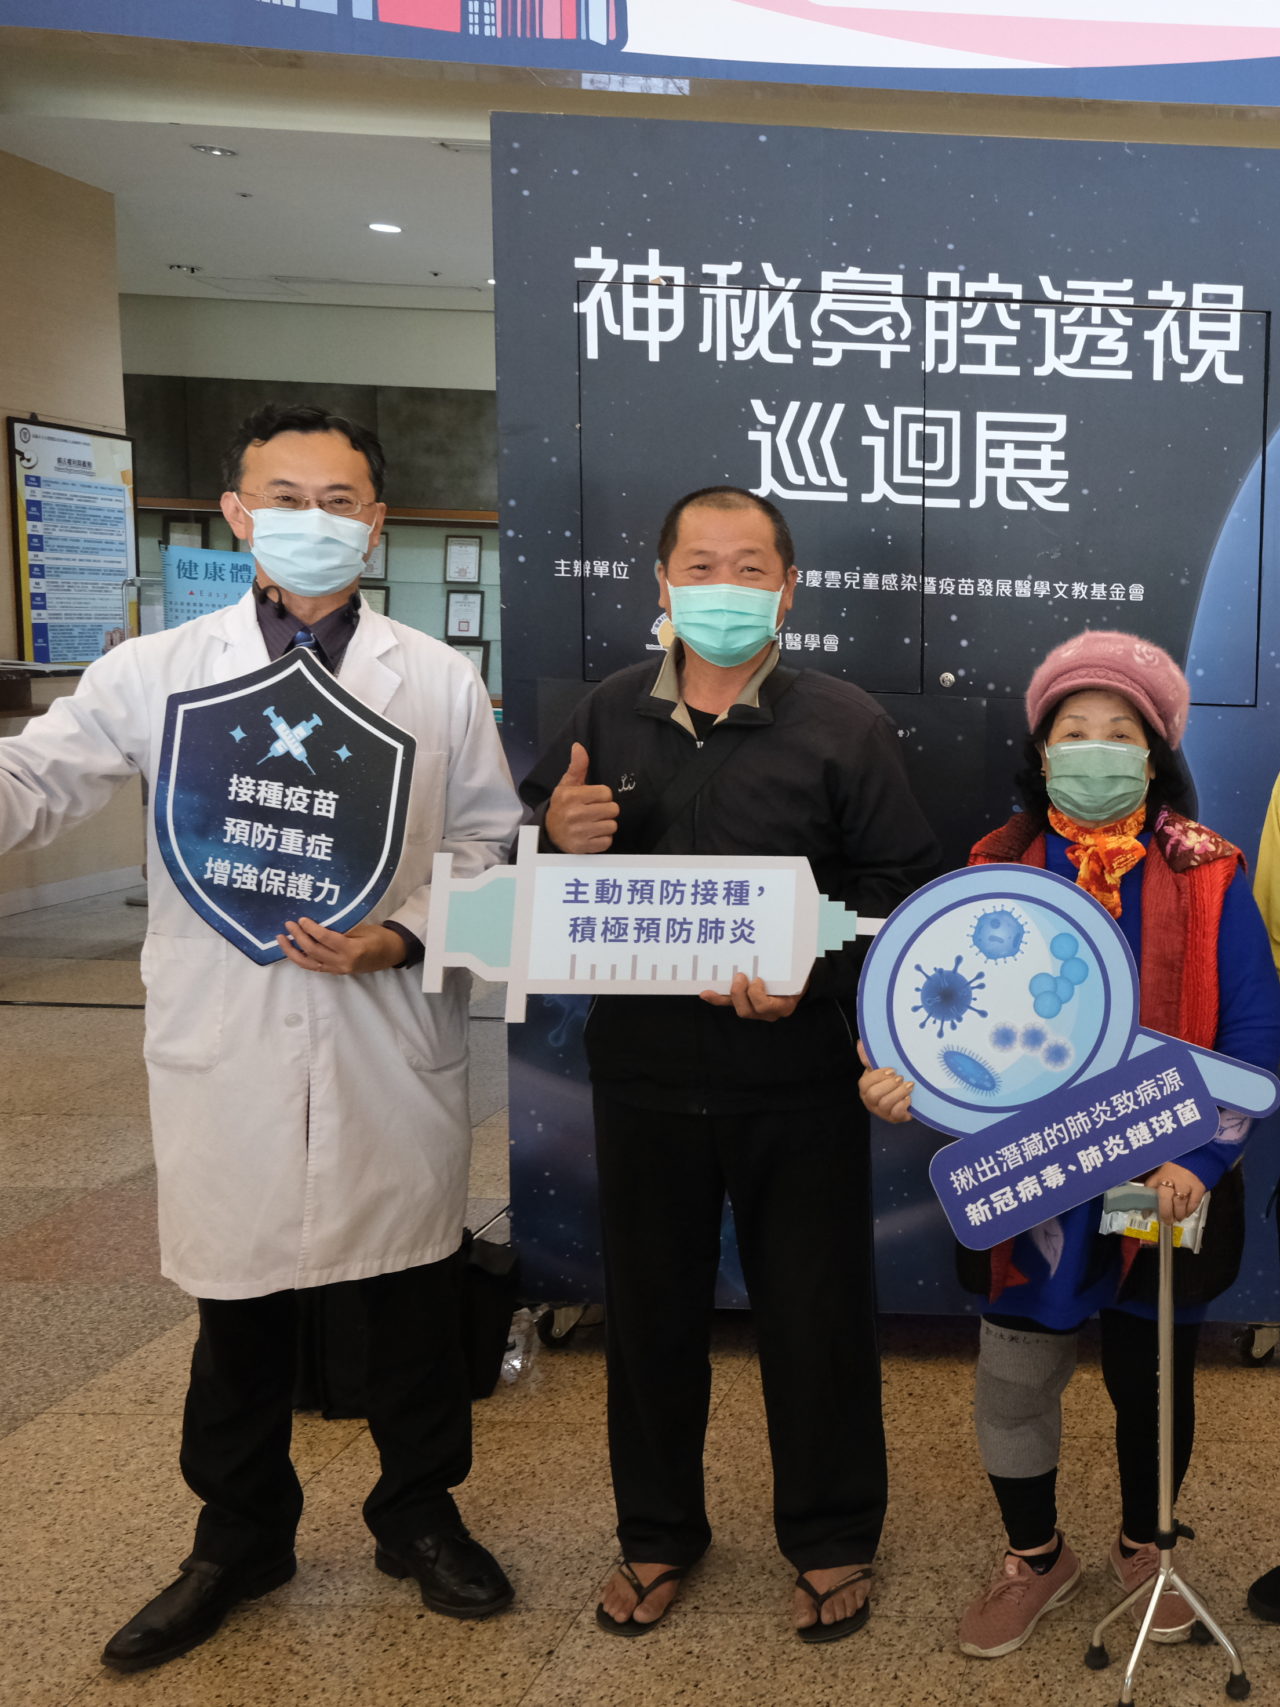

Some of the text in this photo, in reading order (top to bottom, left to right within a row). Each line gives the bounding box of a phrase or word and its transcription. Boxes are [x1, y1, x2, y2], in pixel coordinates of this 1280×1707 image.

[573, 246, 1244, 385] 神秘鼻腔透視
[747, 398, 1069, 512] 巡迴展
[176, 559, 253, 583] 健康體
[553, 559, 630, 580] 主辦單位
[227, 773, 340, 819] 接種疫苗
[222, 817, 335, 862] 預防重症
[203, 856, 341, 906] 增強保護力
[568, 915, 756, 944] 積極預防肺炎
[949, 1066, 1185, 1196] 揪出潛藏的肺炎致病源
[964, 1097, 1202, 1227] 新冠病毒、肺炎鏈球菌
